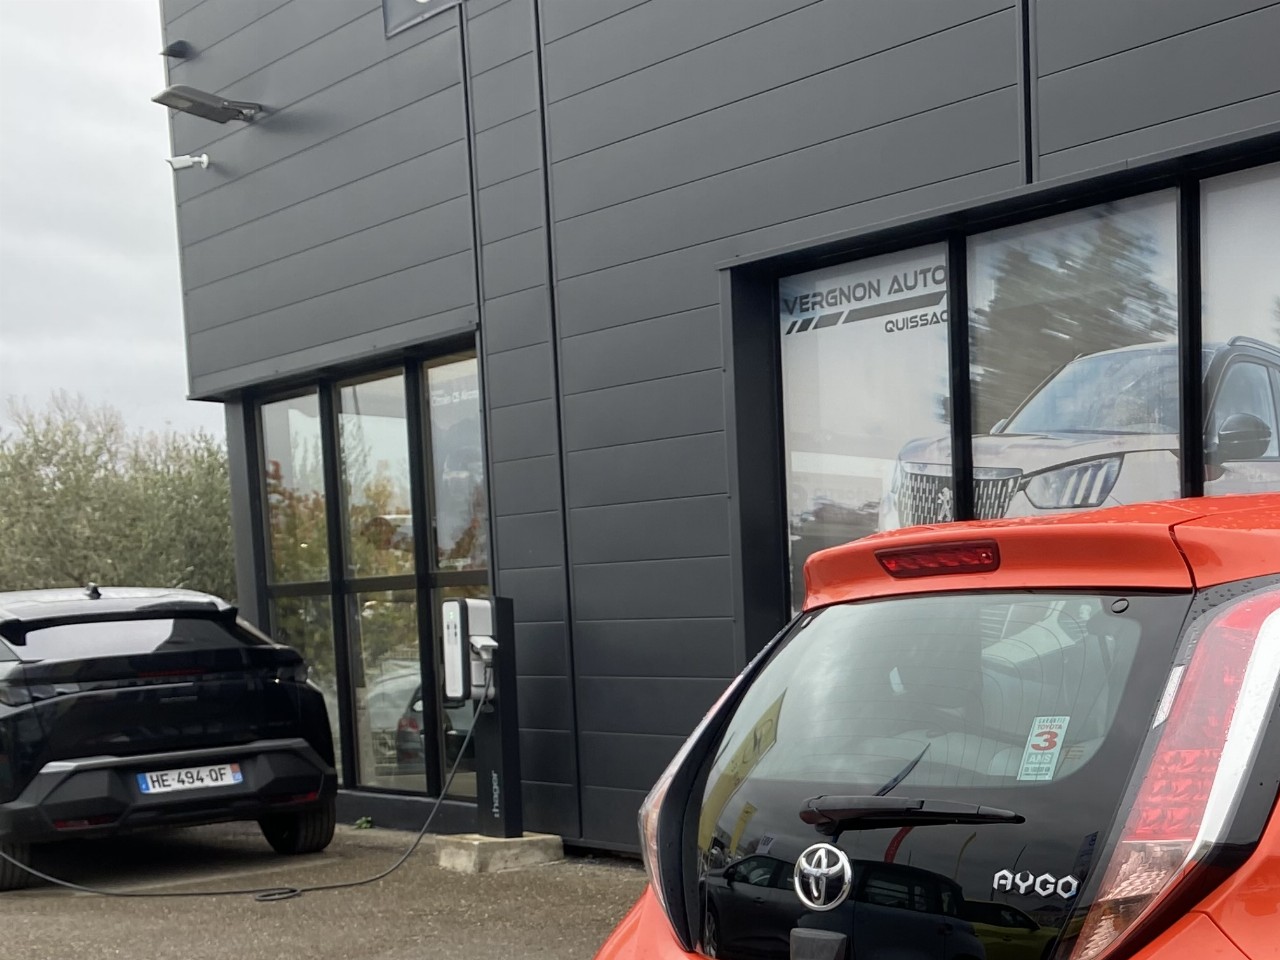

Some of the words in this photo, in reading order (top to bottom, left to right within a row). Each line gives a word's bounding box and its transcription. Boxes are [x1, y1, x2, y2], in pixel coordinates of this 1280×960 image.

[783, 278, 881, 316] VERGNON
[887, 264, 947, 296] AUTO
[884, 309, 948, 334] QUISSAC
[1031, 730, 1058, 751] 3
[1029, 753, 1052, 763] ANS
[992, 869, 1079, 899] AYGO
